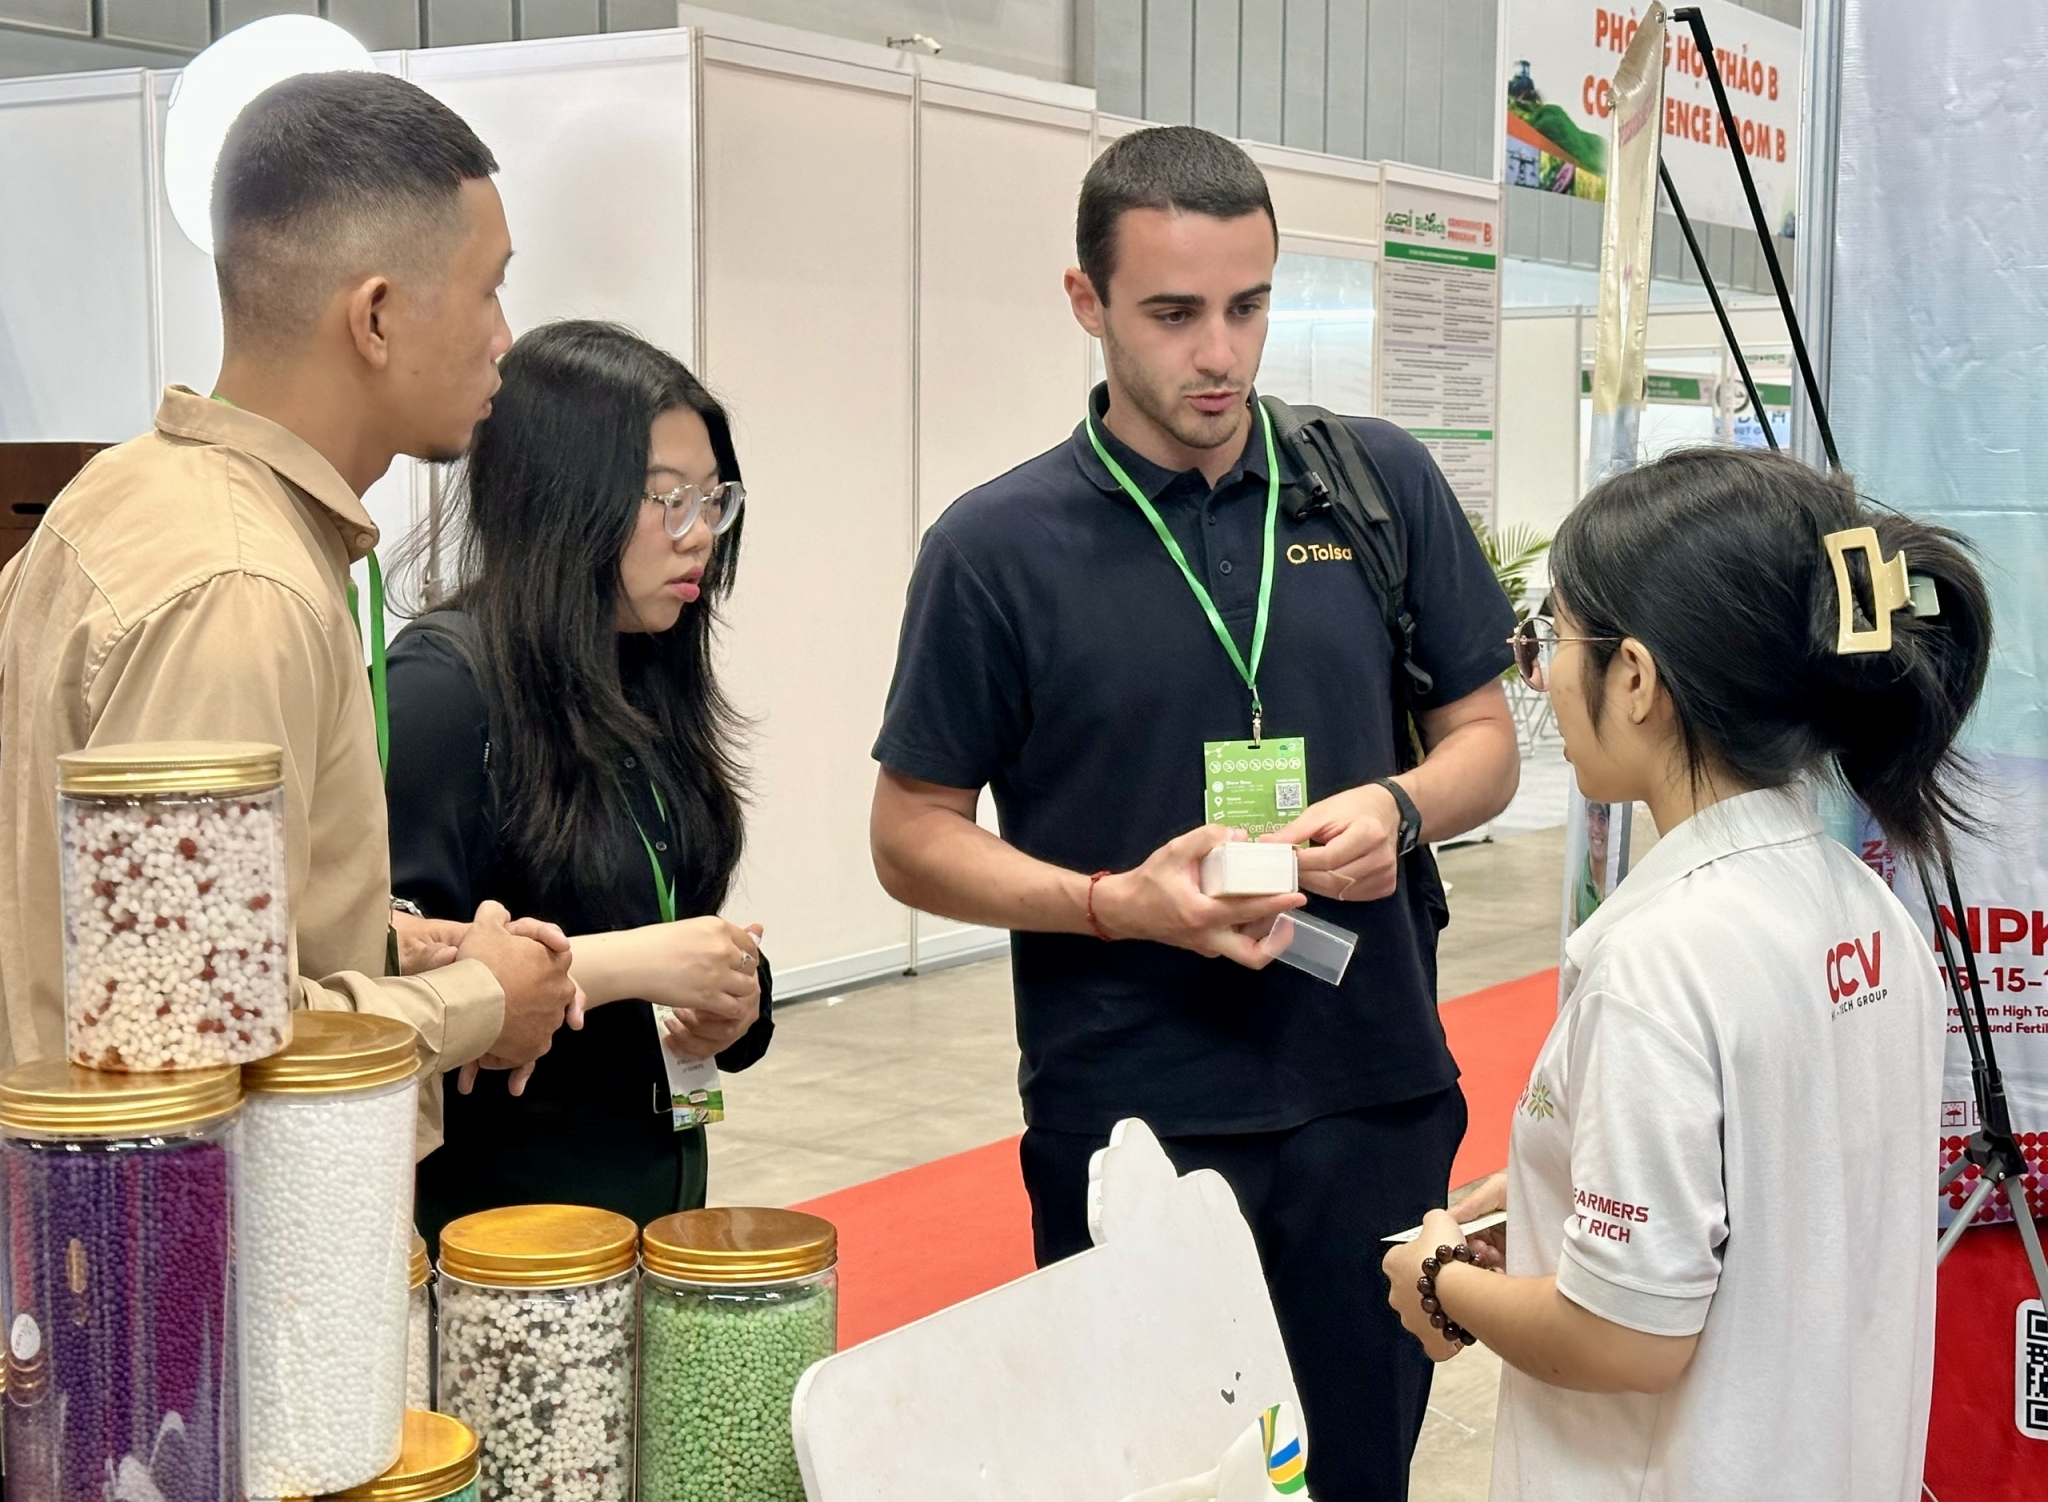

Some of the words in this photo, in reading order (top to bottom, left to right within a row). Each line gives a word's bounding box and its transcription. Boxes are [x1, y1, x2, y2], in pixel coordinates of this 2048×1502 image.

[1716, 43, 1763, 96] THẢO
[1768, 65, 1778, 101] B
[1583, 75, 1711, 146] COENCE
[1716, 112, 1771, 160] ROM
[1776, 127, 1785, 163] B
[1307, 543, 1353, 561] Tolsa
[1826, 930, 1881, 1004] CCV
[1856, 989, 1888, 1007] GROUP
[2003, 1005, 2032, 1020] High
[1588, 1219, 1631, 1244] RICH
